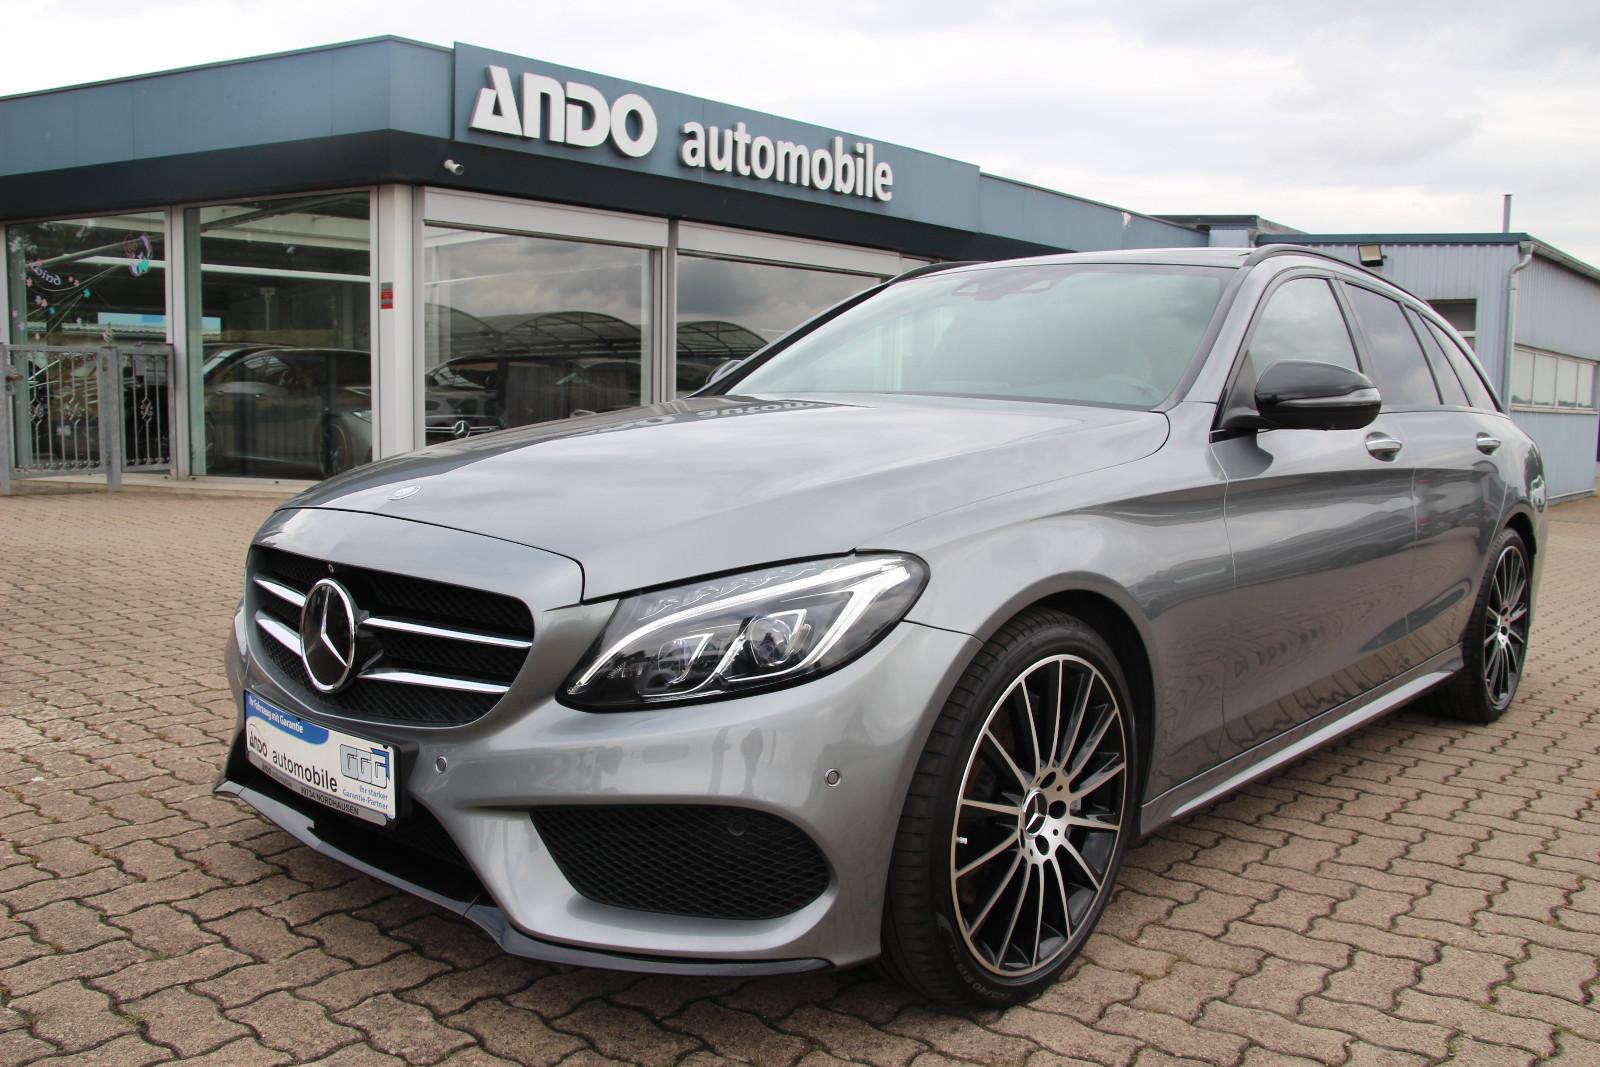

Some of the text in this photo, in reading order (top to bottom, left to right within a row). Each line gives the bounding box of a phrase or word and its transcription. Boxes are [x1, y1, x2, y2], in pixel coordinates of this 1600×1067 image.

[468, 64, 894, 202] ANDO automobile
[280, 715, 304, 734] Garantie
[272, 750, 338, 793] automobile
[316, 793, 359, 816] NORDHAUSEN
[342, 788, 388, 810] Garantie-Partner
[368, 789, 388, 801] starker
